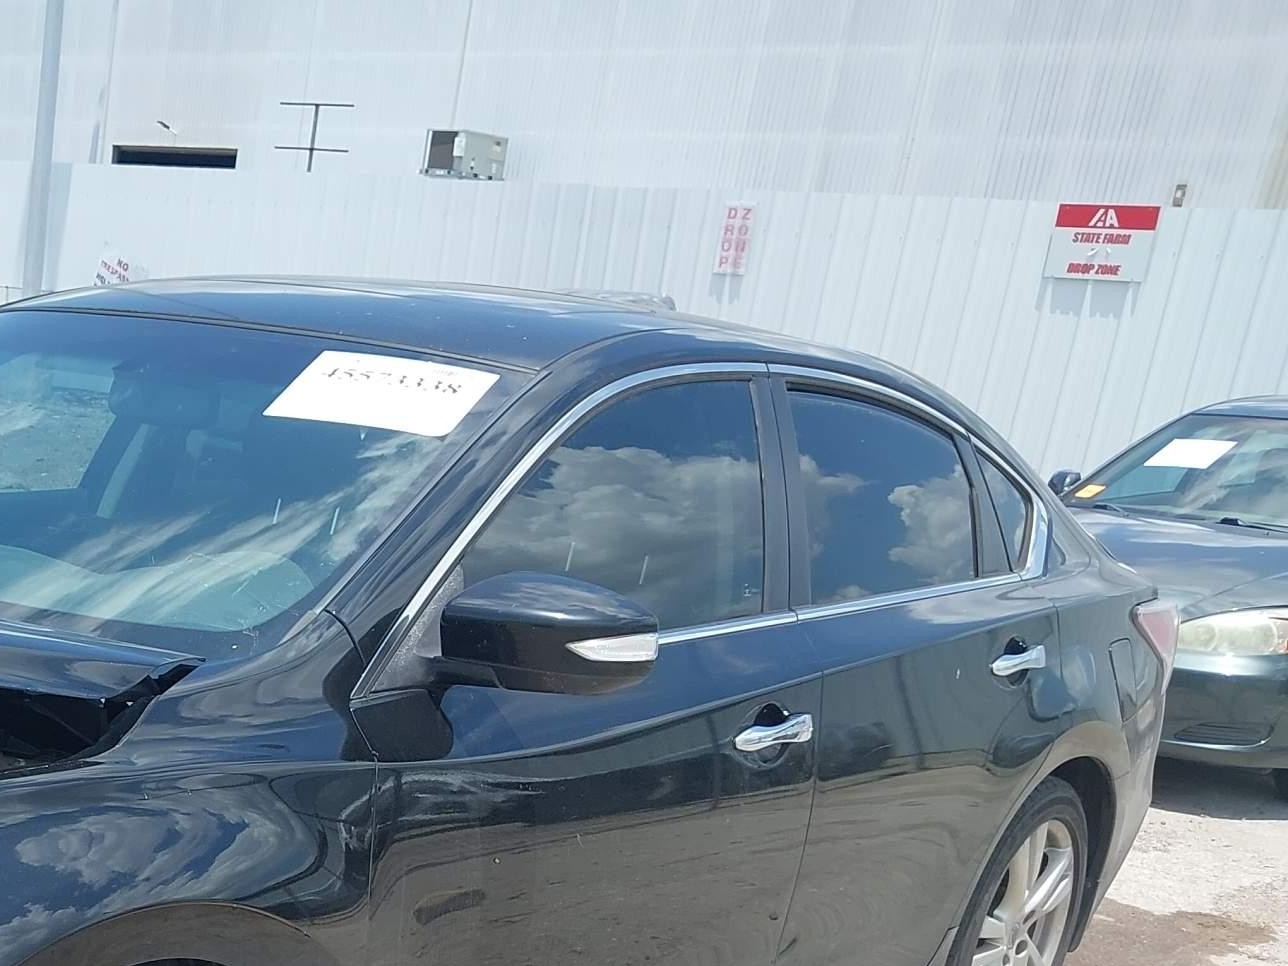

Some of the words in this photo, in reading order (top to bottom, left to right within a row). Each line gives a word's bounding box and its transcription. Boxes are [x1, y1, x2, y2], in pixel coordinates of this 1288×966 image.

[1072, 232, 1101, 245] STATE
[1102, 233, 1132, 246] FARM
[1066, 262, 1095, 275] DROP
[1094, 264, 1122, 276] ZONE
